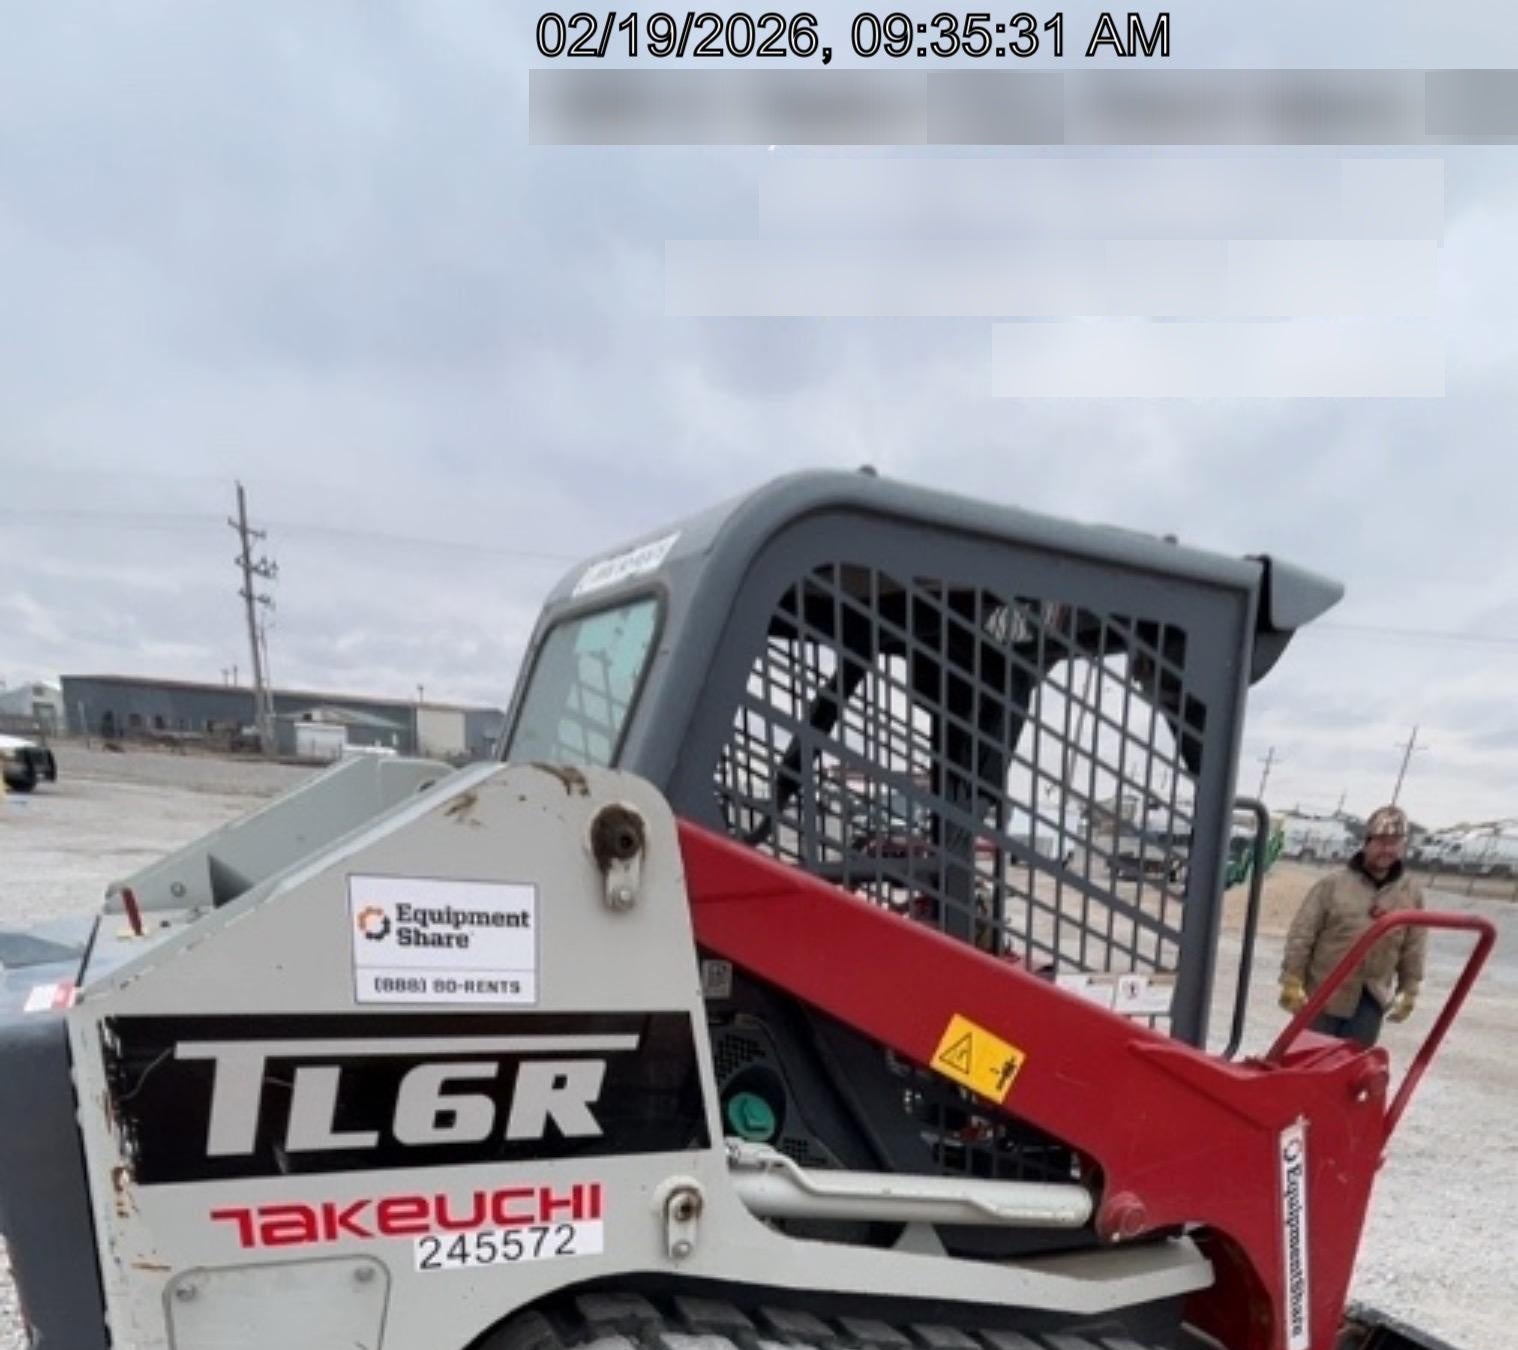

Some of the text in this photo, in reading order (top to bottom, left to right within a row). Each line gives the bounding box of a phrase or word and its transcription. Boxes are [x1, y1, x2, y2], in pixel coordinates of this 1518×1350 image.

[395, 903, 531, 928] Equipment
[396, 927, 470, 948] Share
[374, 977, 427, 993] (888)
[174, 1034, 640, 1157] TL6R
[418, 1224, 577, 1270] 245572
[1283, 1163, 1304, 1338] EquipmentShare
